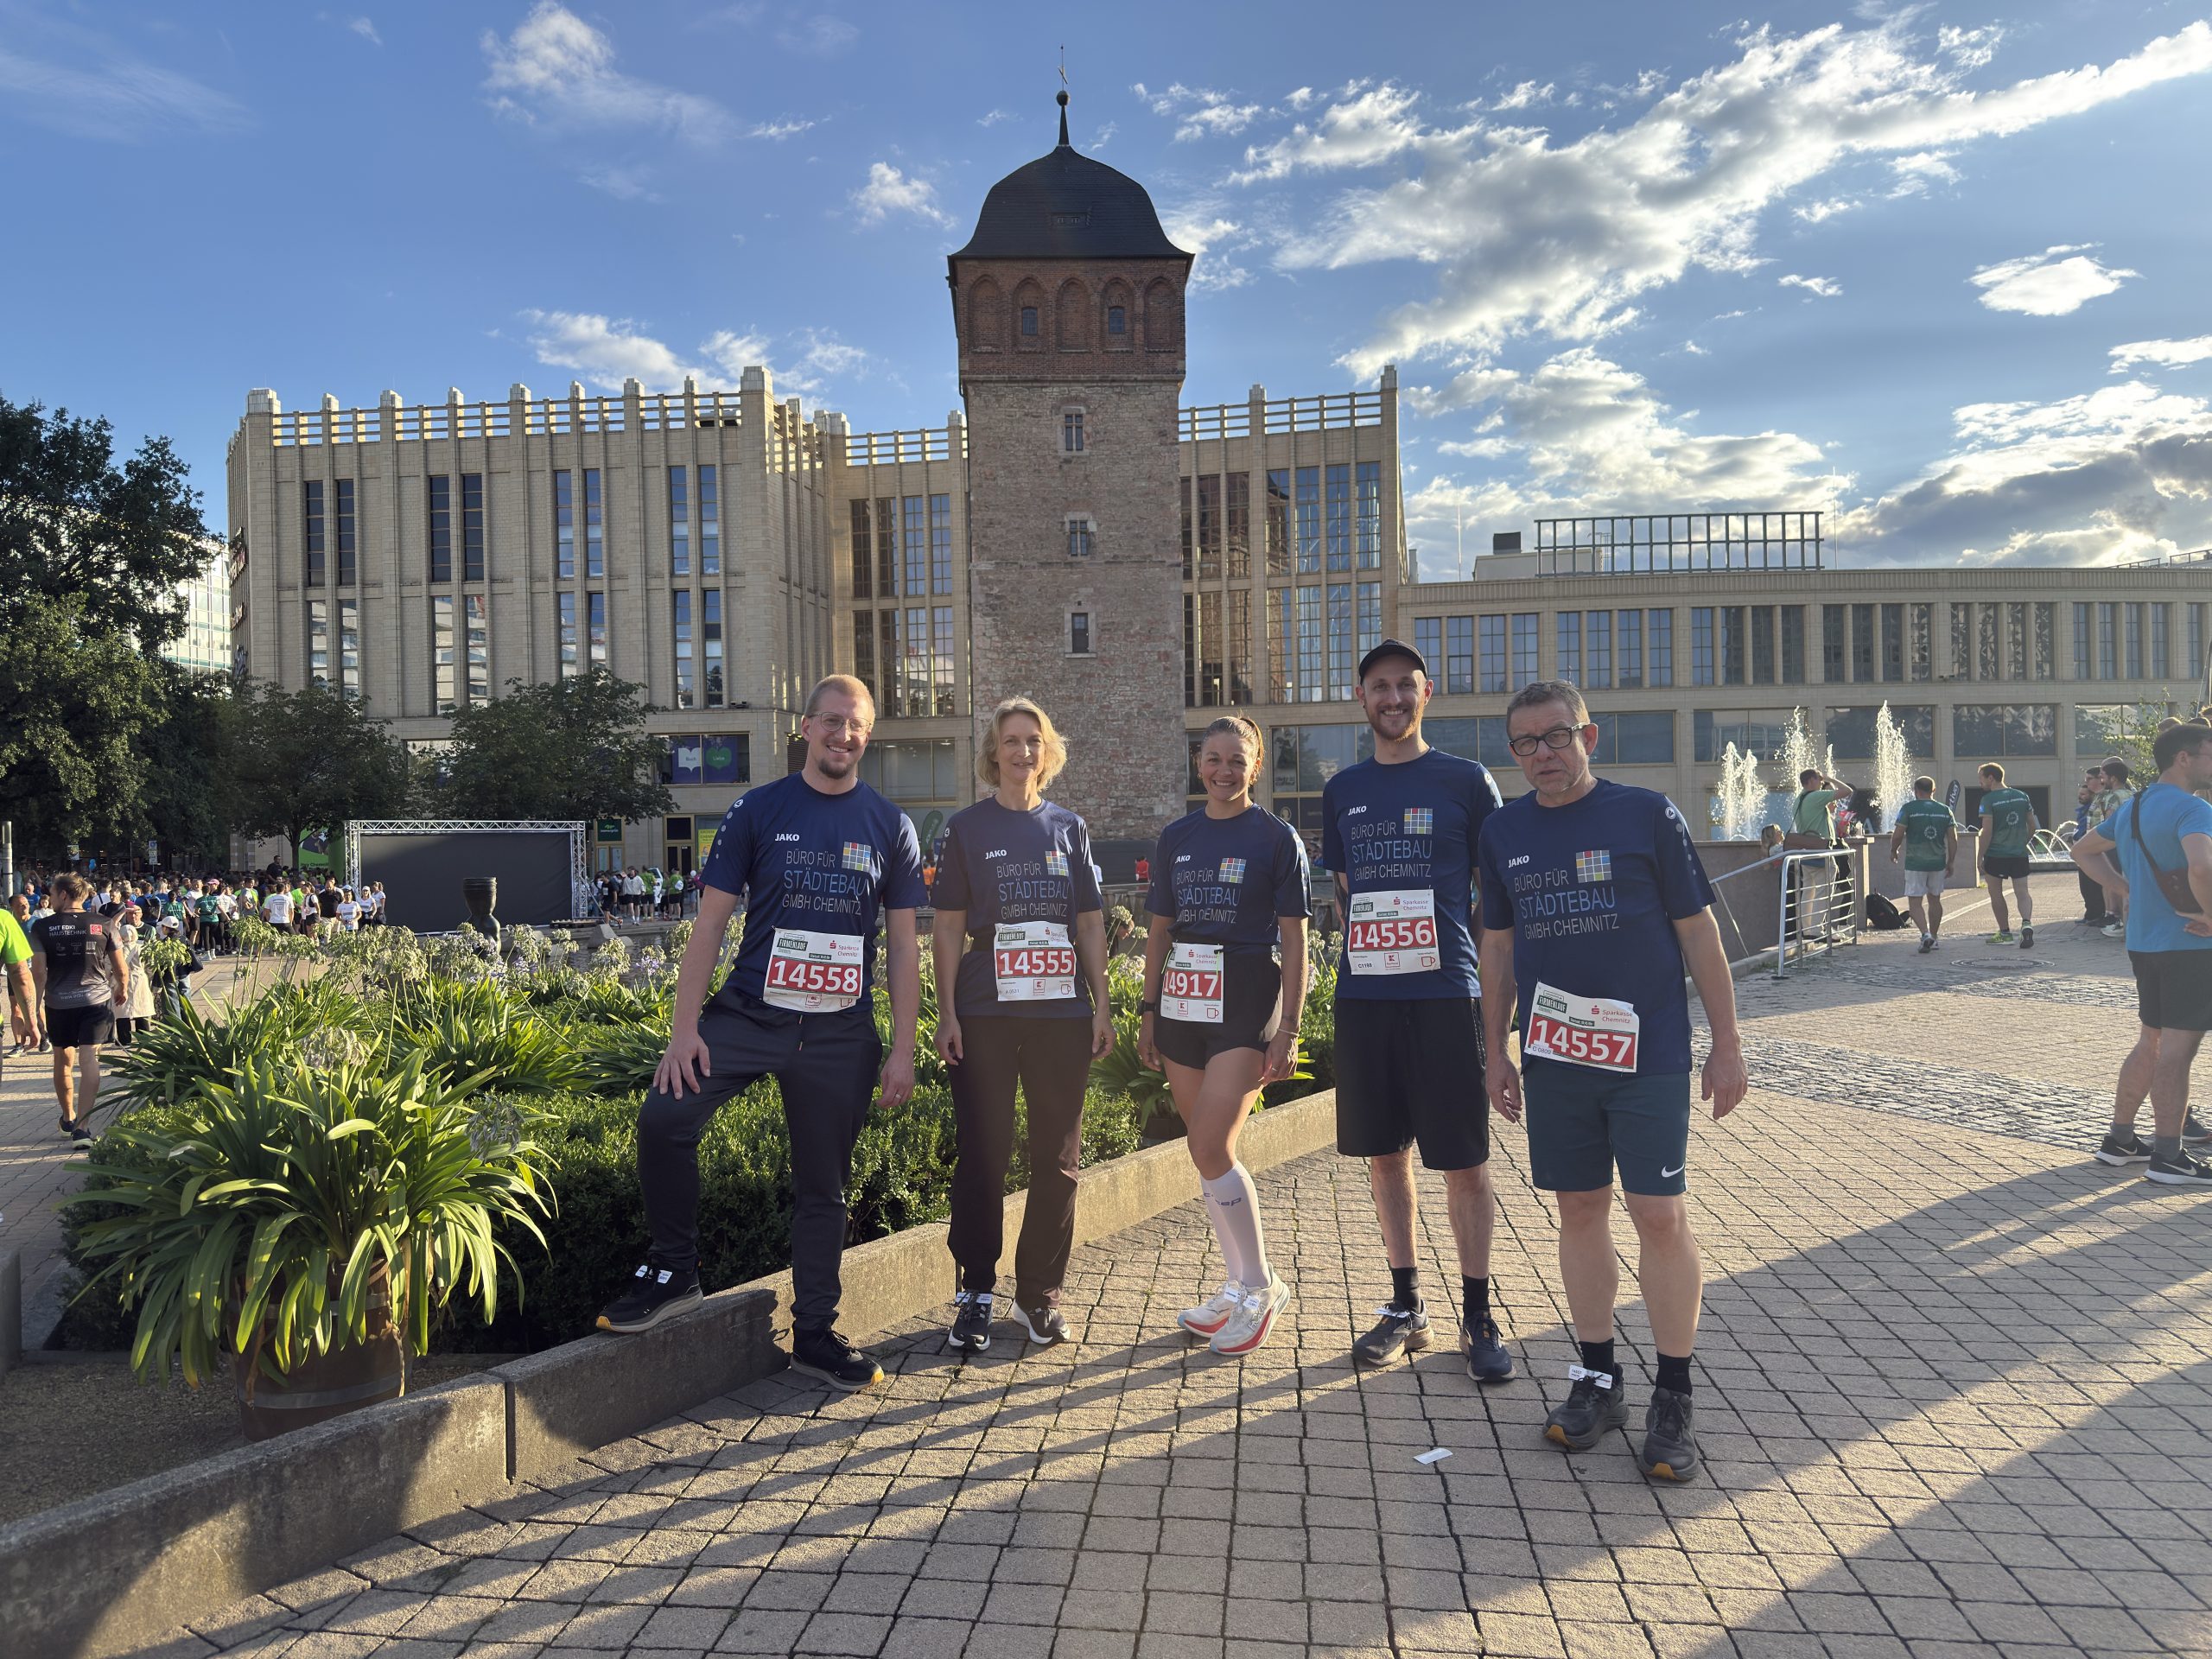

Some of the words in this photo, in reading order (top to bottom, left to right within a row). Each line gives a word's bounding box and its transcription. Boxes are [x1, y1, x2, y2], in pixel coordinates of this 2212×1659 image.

[1348, 805, 1367, 816] JAKO
[774, 833, 800, 842] JAKO
[1351, 824, 1374, 840] BÜRO
[1377, 821, 1396, 836] FÜR
[786, 849, 814, 864] BÜRO
[817, 851, 836, 868] FÜR
[985, 849, 1007, 859] JAKO
[1351, 840, 1433, 863] STÄDTEBAU
[1508, 855, 1529, 868] JAKO
[997, 863, 1021, 878] BÜRO
[1023, 861, 1042, 876] FÜR
[1177, 869, 1196, 885] BÜRO
[1198, 868, 1213, 883] FÜR
[1355, 866, 1376, 881] GMBH
[1379, 864, 1431, 878] CHEMNITZ
[1514, 873, 1541, 892] BÜRO
[1545, 868, 1569, 887] FÜR
[784, 868, 868, 895] STÄDTEBAU
[999, 878, 1069, 901] STÄDTEBAU
[783, 893, 810, 909] GMBH
[814, 896, 862, 916] CHEMNITZ
[1177, 885, 1241, 907] STÄDTEBAU
[1519, 887, 1616, 919] STÄDTEBAU
[1001, 904, 1027, 919] GMBH
[1353, 920, 1432, 949] 14556
[1524, 921, 1552, 940] GMBH
[1554, 912, 1620, 937] CHEMNITZ
[1001, 950, 1071, 975] 14555
[772, 961, 858, 993] 14558
[1164, 970, 1218, 997] 14917
[1534, 1020, 1632, 1063] 14557
